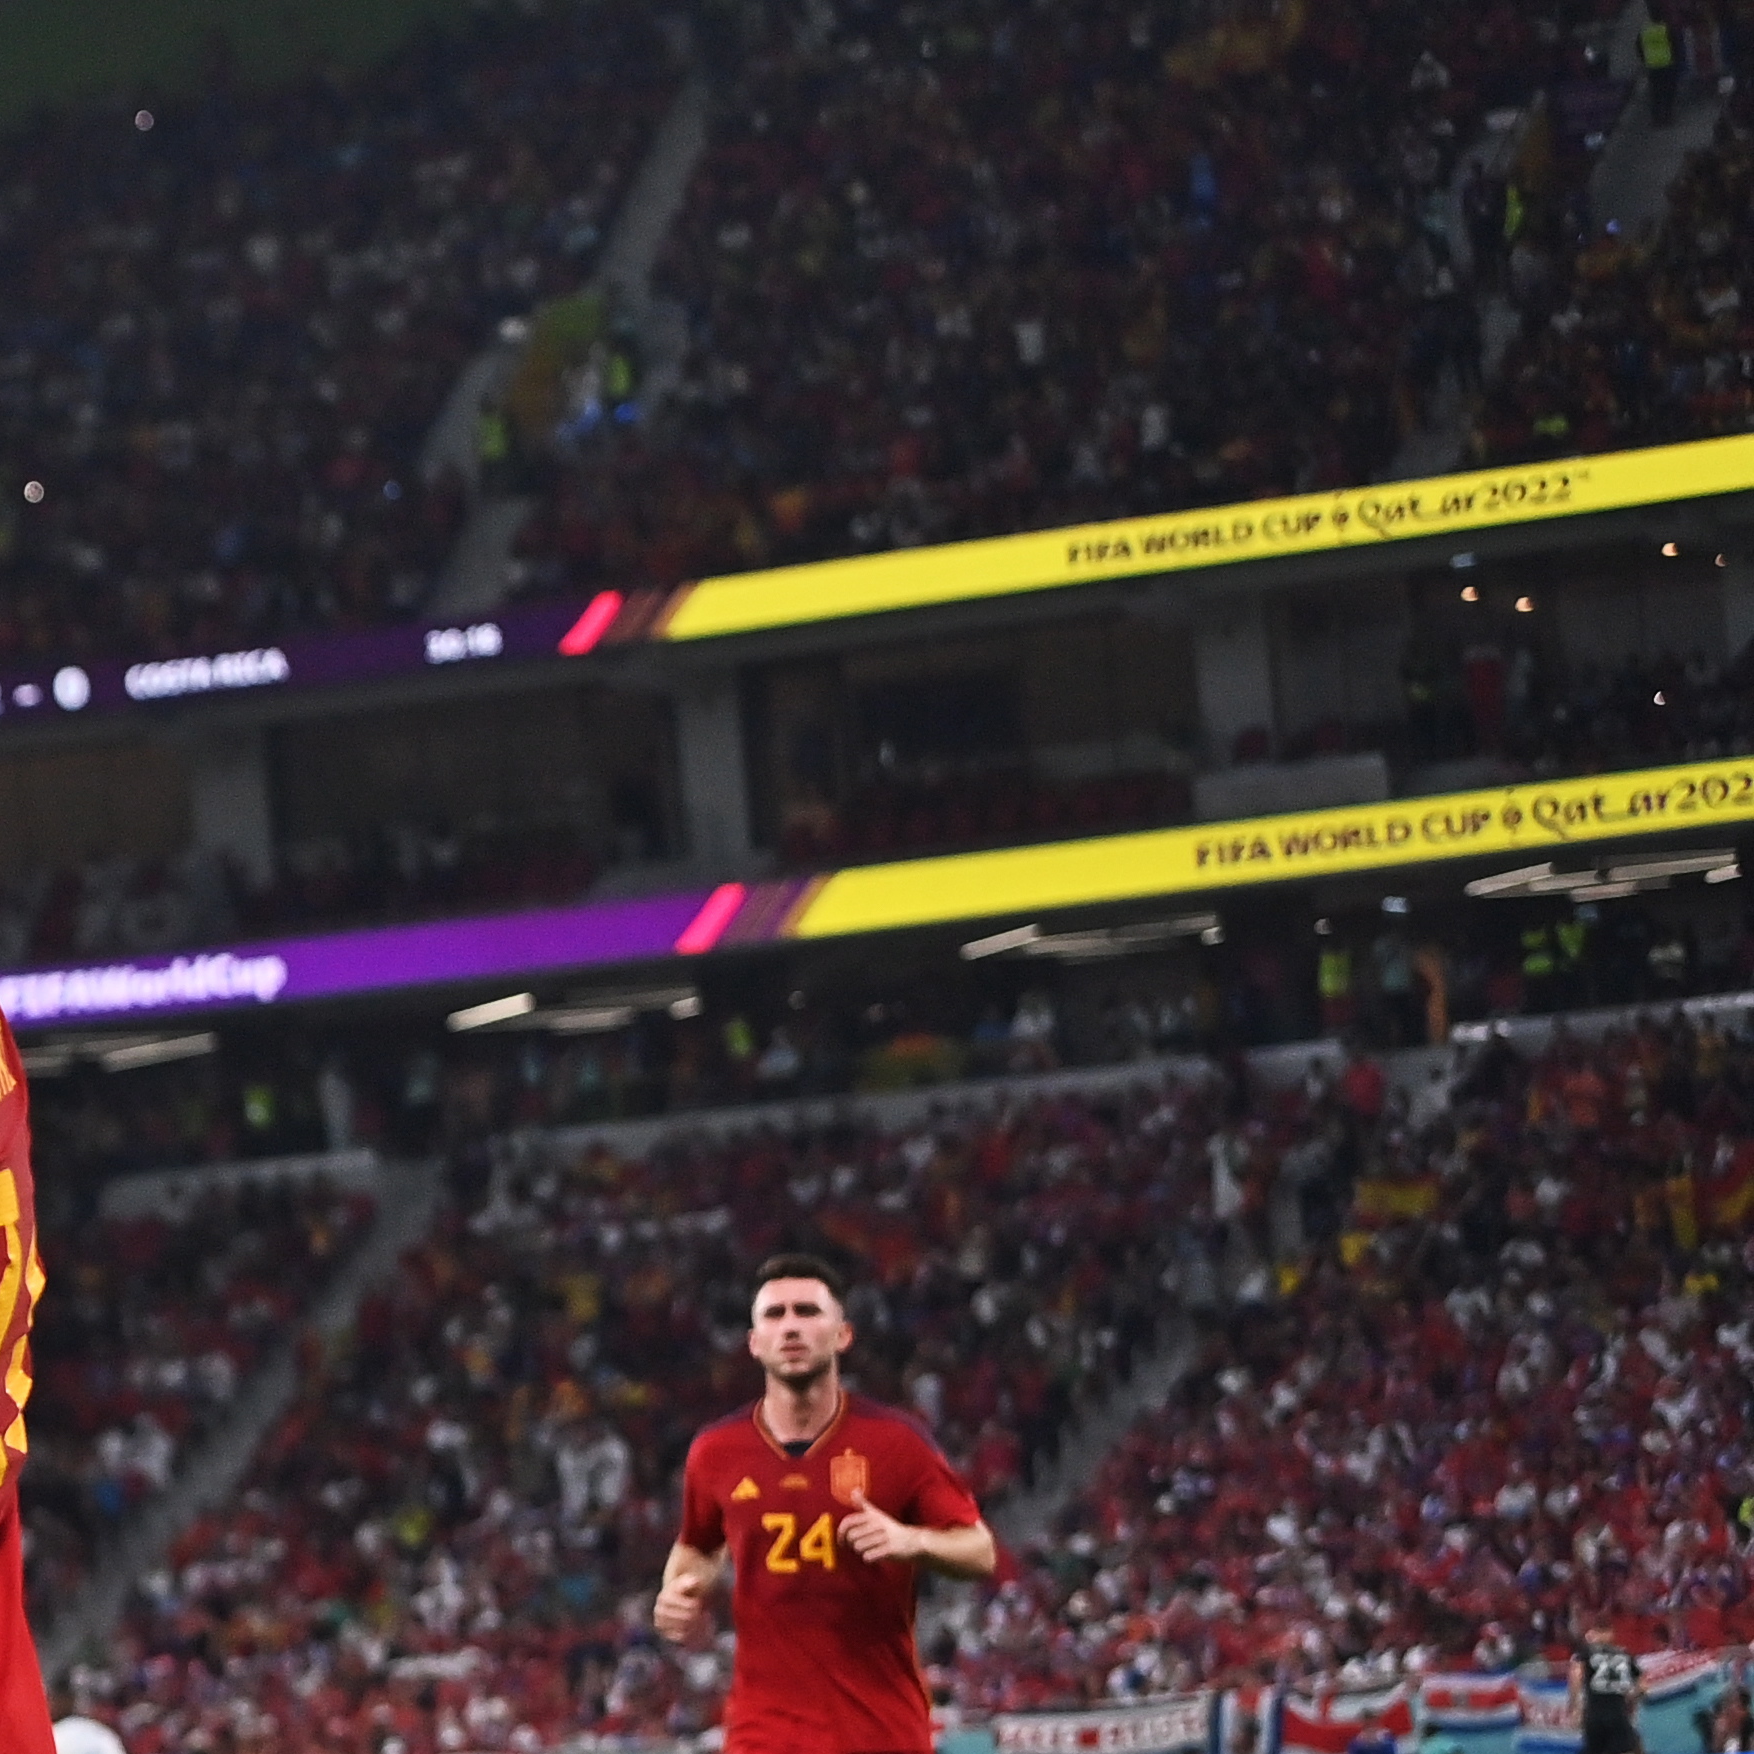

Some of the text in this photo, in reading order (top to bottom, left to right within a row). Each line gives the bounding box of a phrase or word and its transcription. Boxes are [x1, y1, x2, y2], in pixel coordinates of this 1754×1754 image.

[1066, 538, 1131, 563] FIFA
[1142, 522, 1254, 554] WORLD
[1261, 512, 1321, 541] CUP
[1196, 836, 1272, 868] FIFA
[1279, 818, 1411, 856] WORLD
[1421, 808, 1491, 842] CUP
[761, 1511, 836, 1573] 24
